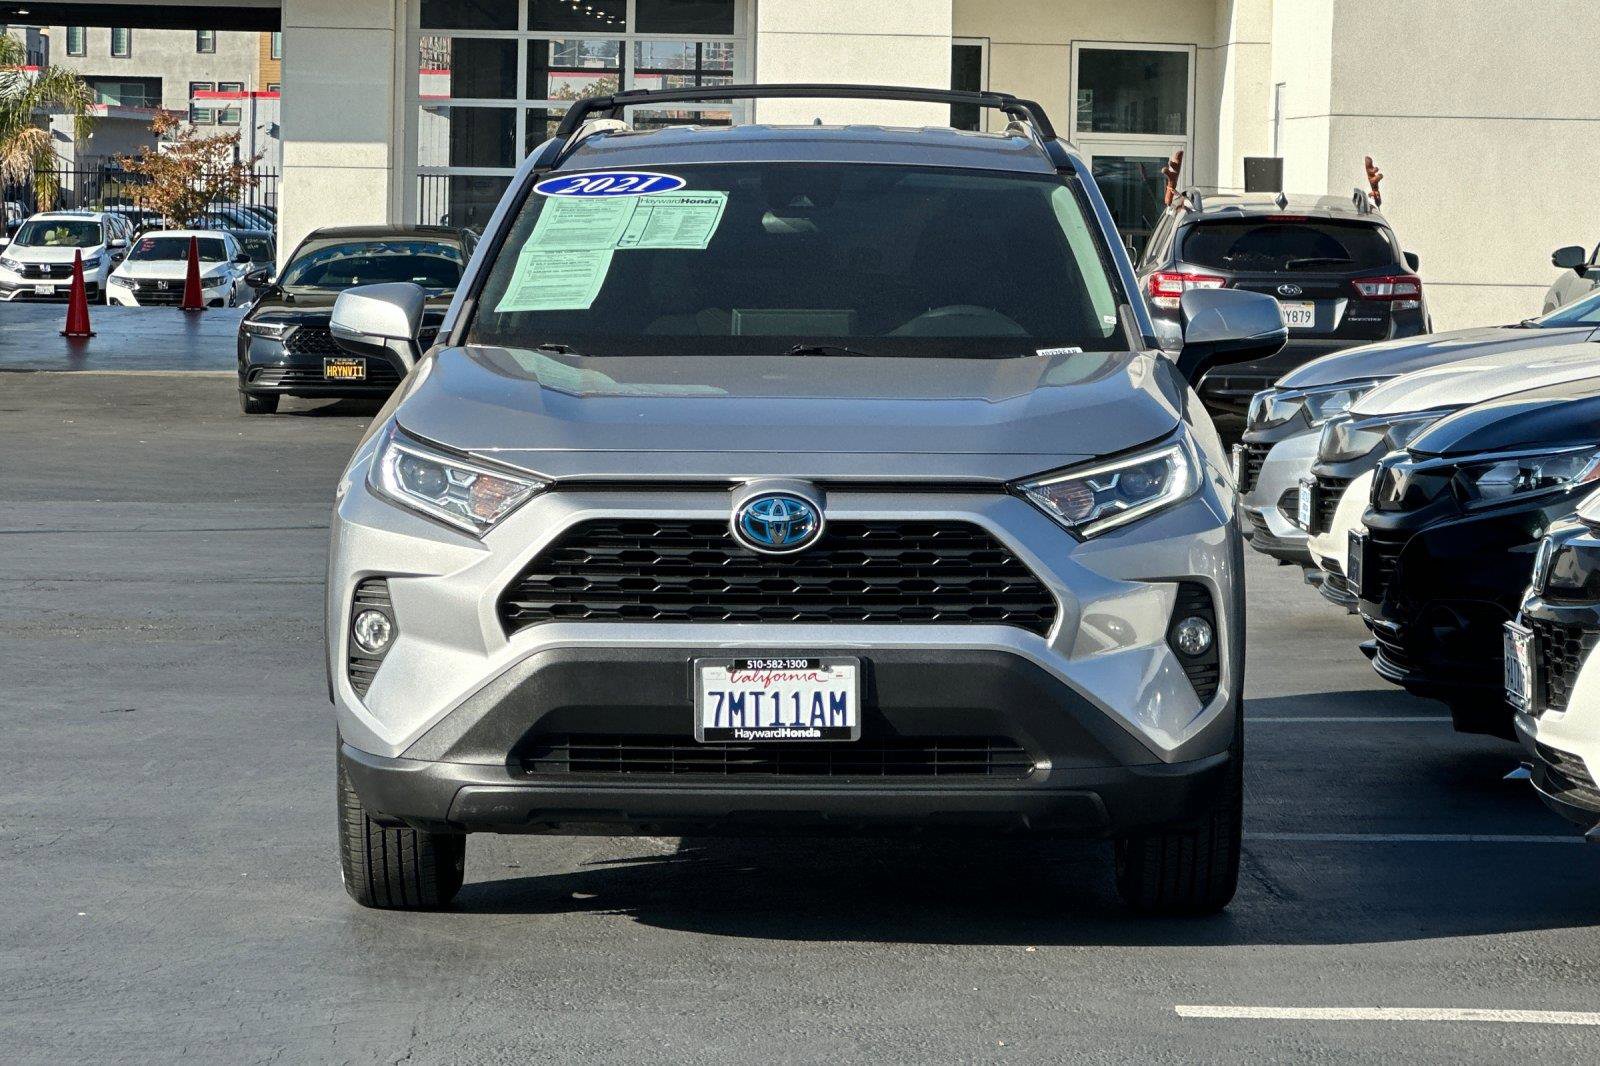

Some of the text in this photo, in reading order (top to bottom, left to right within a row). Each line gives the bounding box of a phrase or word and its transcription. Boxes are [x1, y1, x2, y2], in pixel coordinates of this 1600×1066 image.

[559, 176, 658, 194] 2021
[640, 197, 719, 206] HaywardHonda
[746, 659, 808, 669] 510-582-1300
[730, 669, 829, 689] California
[708, 691, 847, 727] 7MT11AM
[734, 728, 821, 740] HaywardHonda
